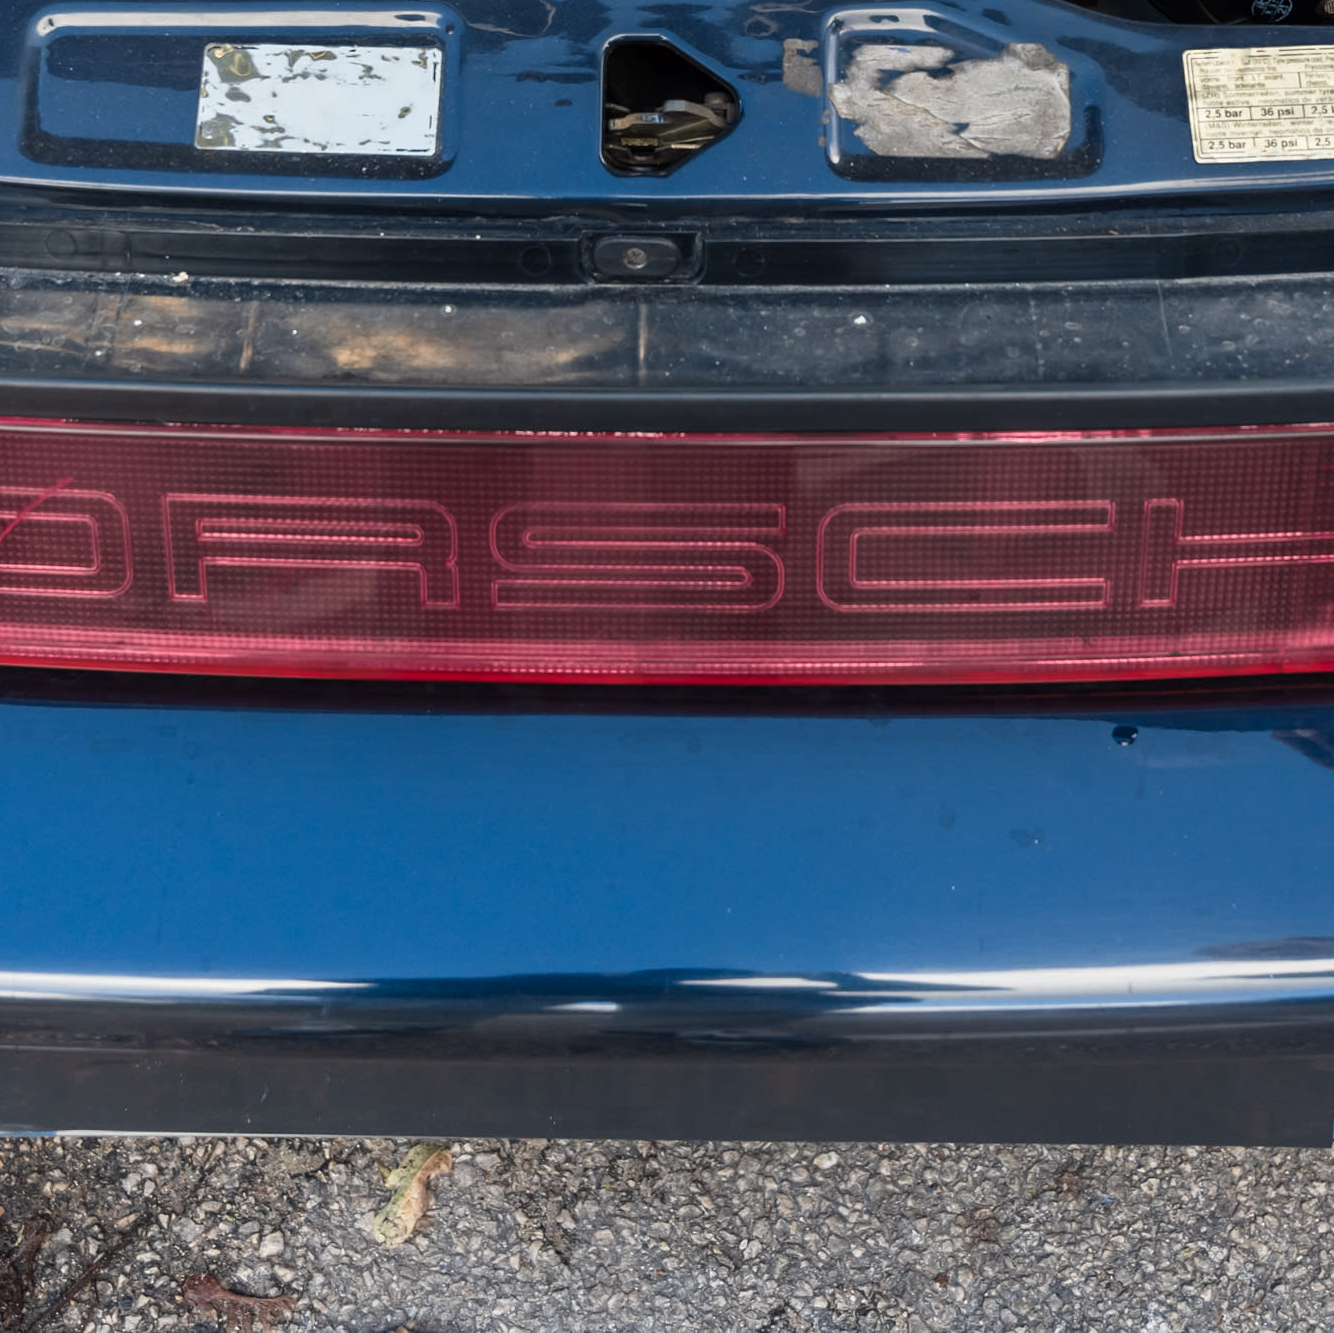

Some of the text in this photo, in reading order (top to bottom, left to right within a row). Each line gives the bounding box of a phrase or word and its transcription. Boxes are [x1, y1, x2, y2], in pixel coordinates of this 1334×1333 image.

[1205, 109, 1243, 119] 2,5 bar
[1260, 106, 1295, 119] 36 psi
[1311, 105, 1328, 115] 2,5
[1208, 140, 1246, 150] 2,5 bar
[1264, 138, 1298, 150] 36 psi
[1315, 137, 1331, 147] 2,5
